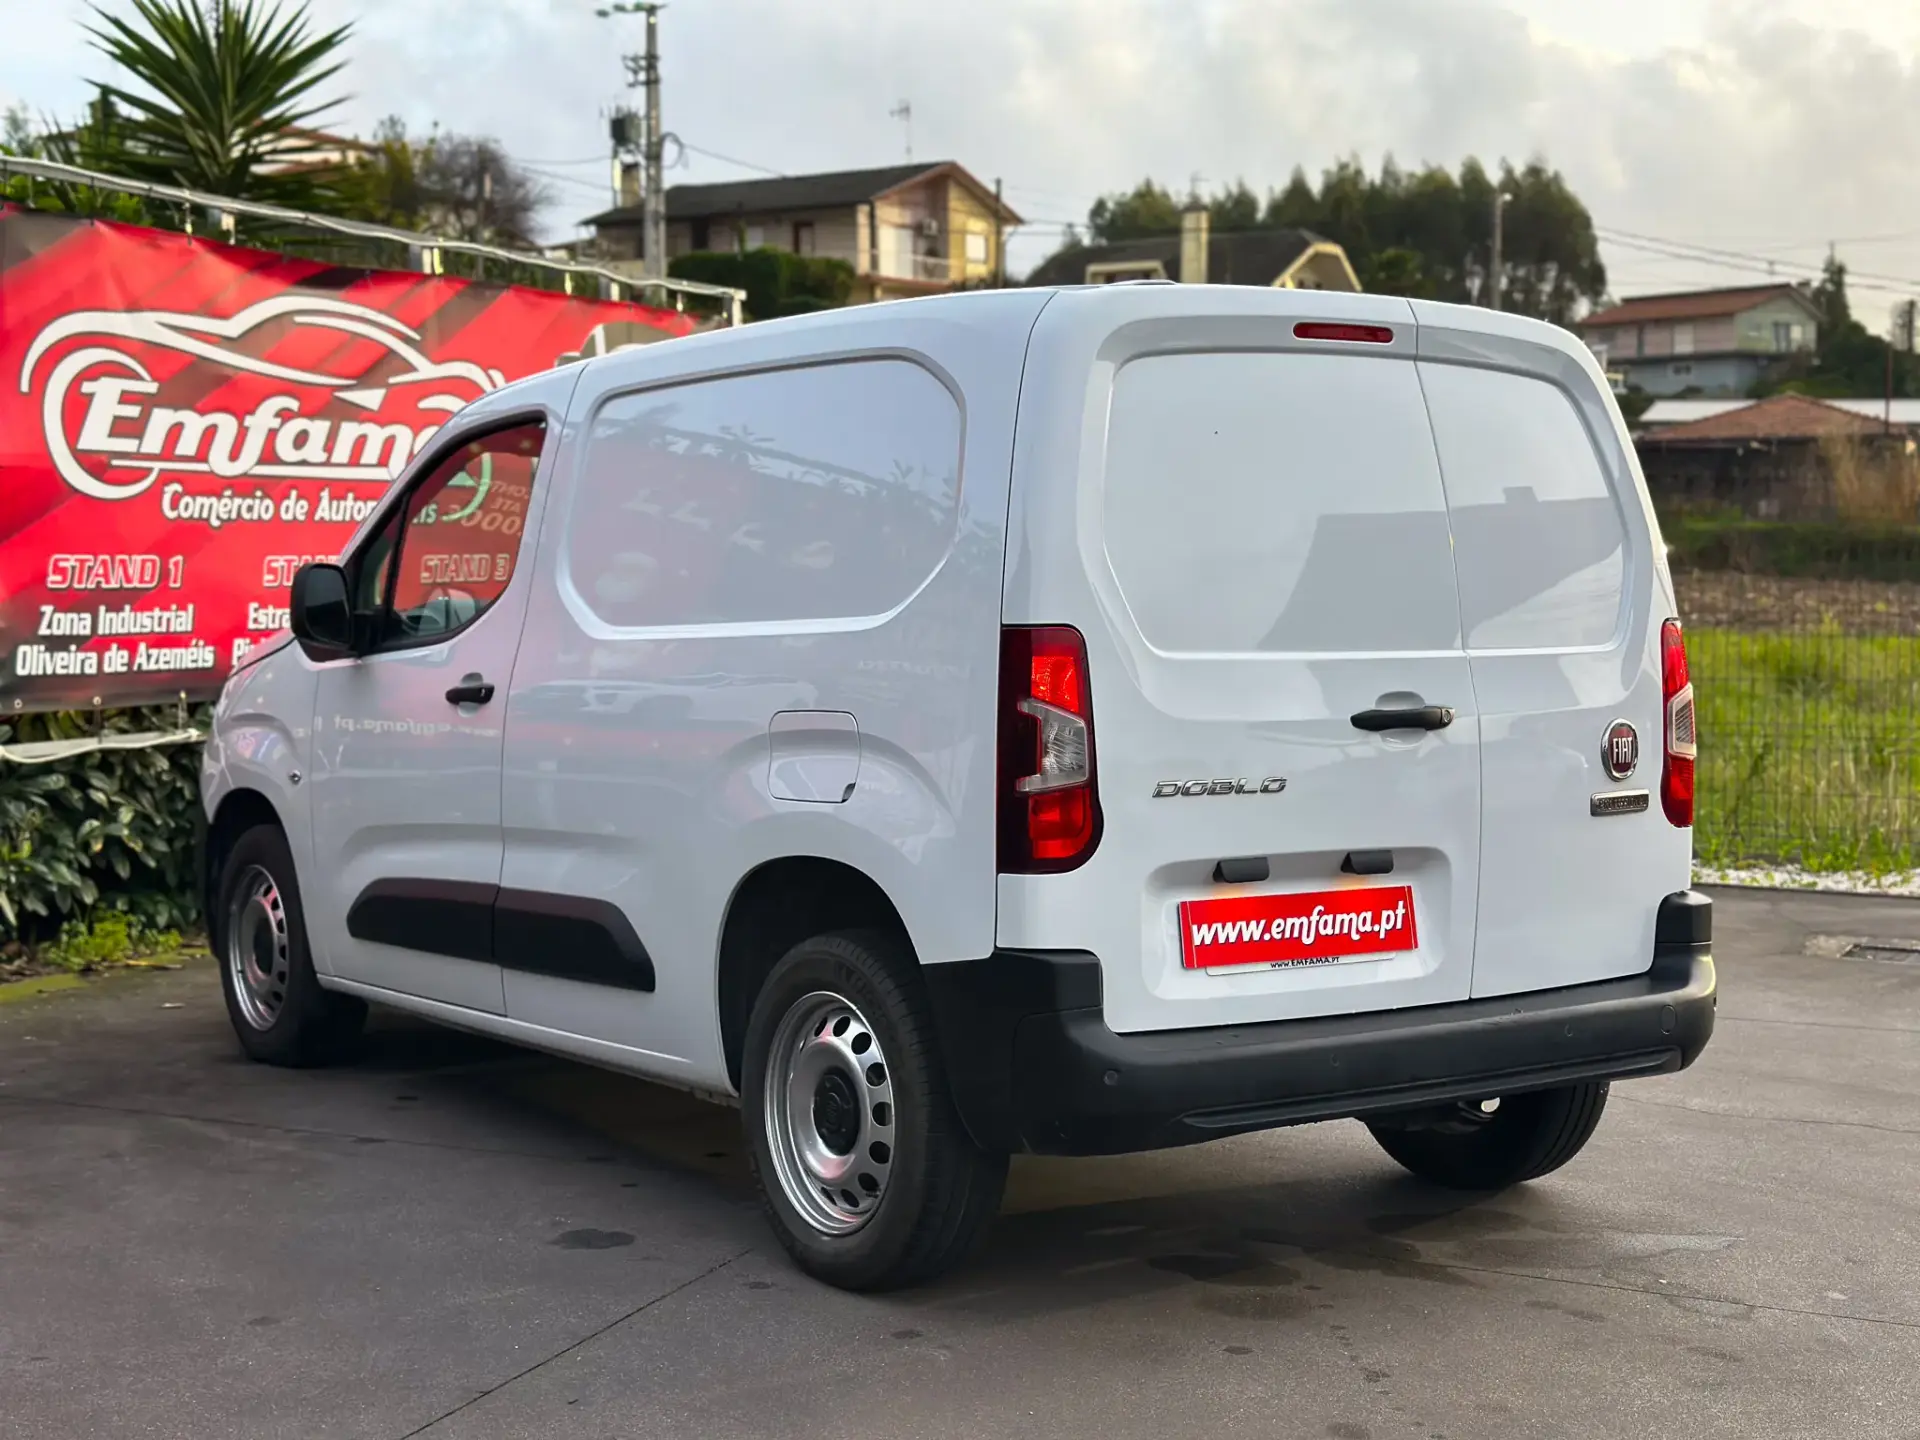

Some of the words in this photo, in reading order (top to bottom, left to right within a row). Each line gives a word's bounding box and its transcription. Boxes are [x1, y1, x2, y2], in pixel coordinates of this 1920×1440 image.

[76, 376, 440, 478] Emfam
[161, 482, 275, 528] Comércio
[280, 489, 308, 522] de
[46, 553, 161, 590] STAND
[168, 554, 185, 589] 1
[420, 554, 491, 583] STAND
[494, 553, 510, 582] 3
[37, 604, 92, 636] Zona
[97, 603, 195, 636] Industrial
[247, 601, 291, 631] Estra
[15, 644, 98, 676] Oliveira
[103, 643, 130, 674] de
[133, 638, 216, 672] Azeméis
[1612, 736, 1633, 764] FIAT
[1191, 900, 1406, 946] www.emfama.pt
